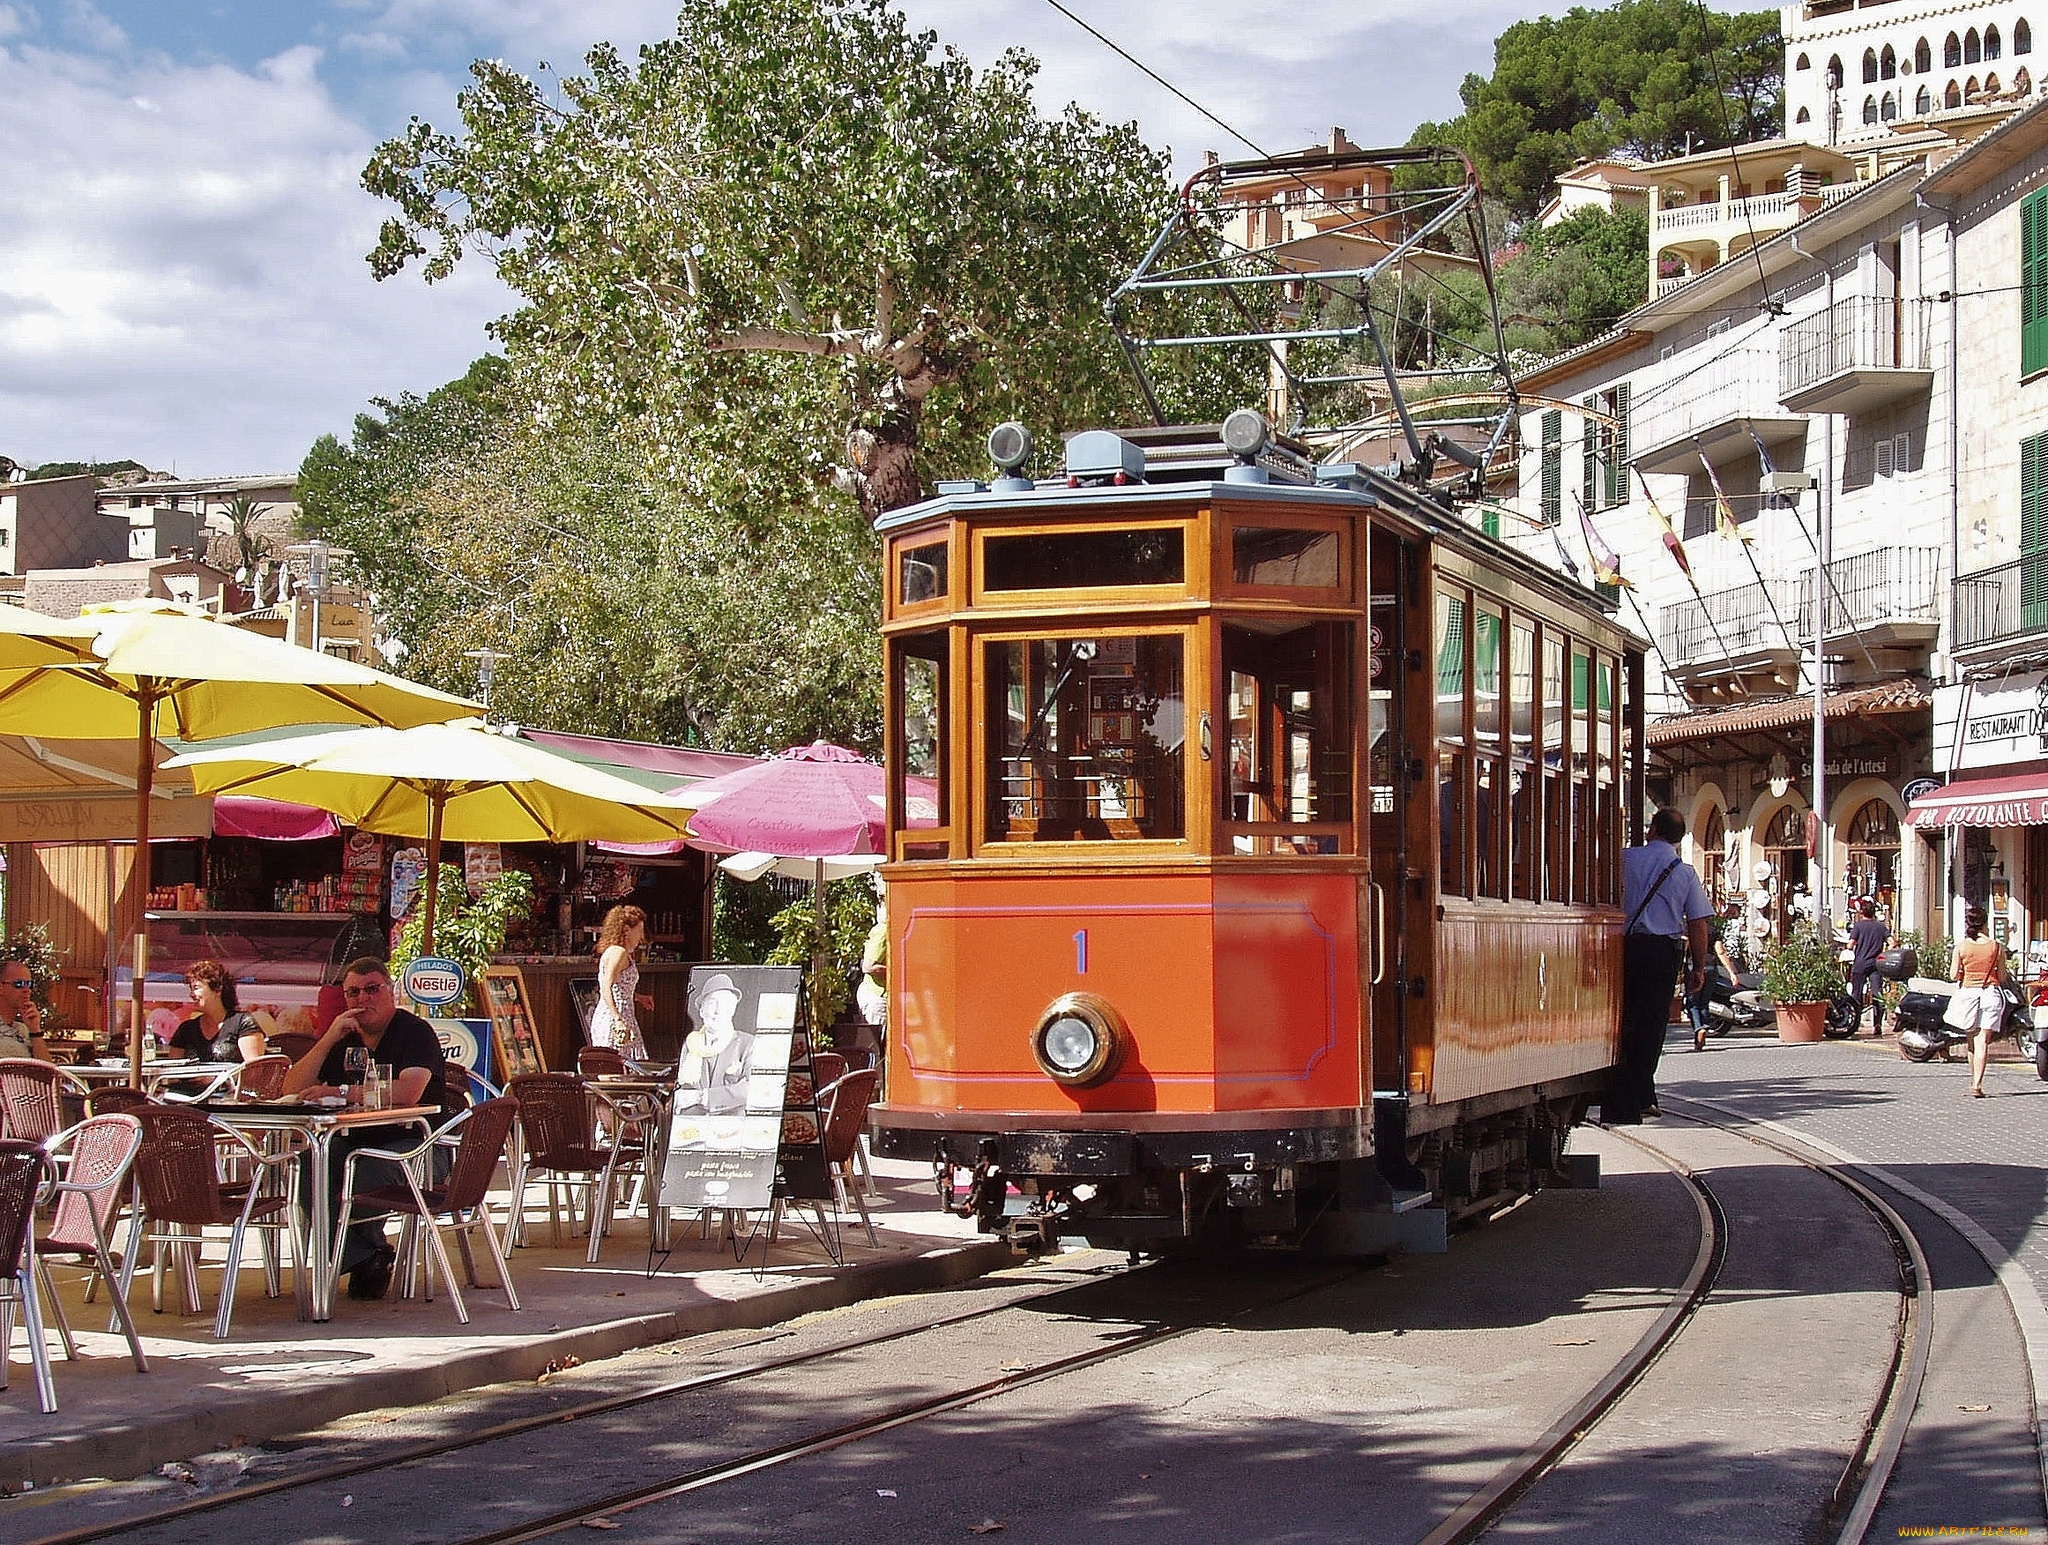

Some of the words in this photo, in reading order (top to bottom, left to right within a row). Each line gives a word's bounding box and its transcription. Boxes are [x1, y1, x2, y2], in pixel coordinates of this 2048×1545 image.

[1970, 715, 2026, 740] RESTAURANT
[1842, 759, 1852, 774] de
[1946, 802, 2032, 825] RISTORANTE
[1072, 929, 1088, 974] 1
[418, 961, 453, 970] HELADOS
